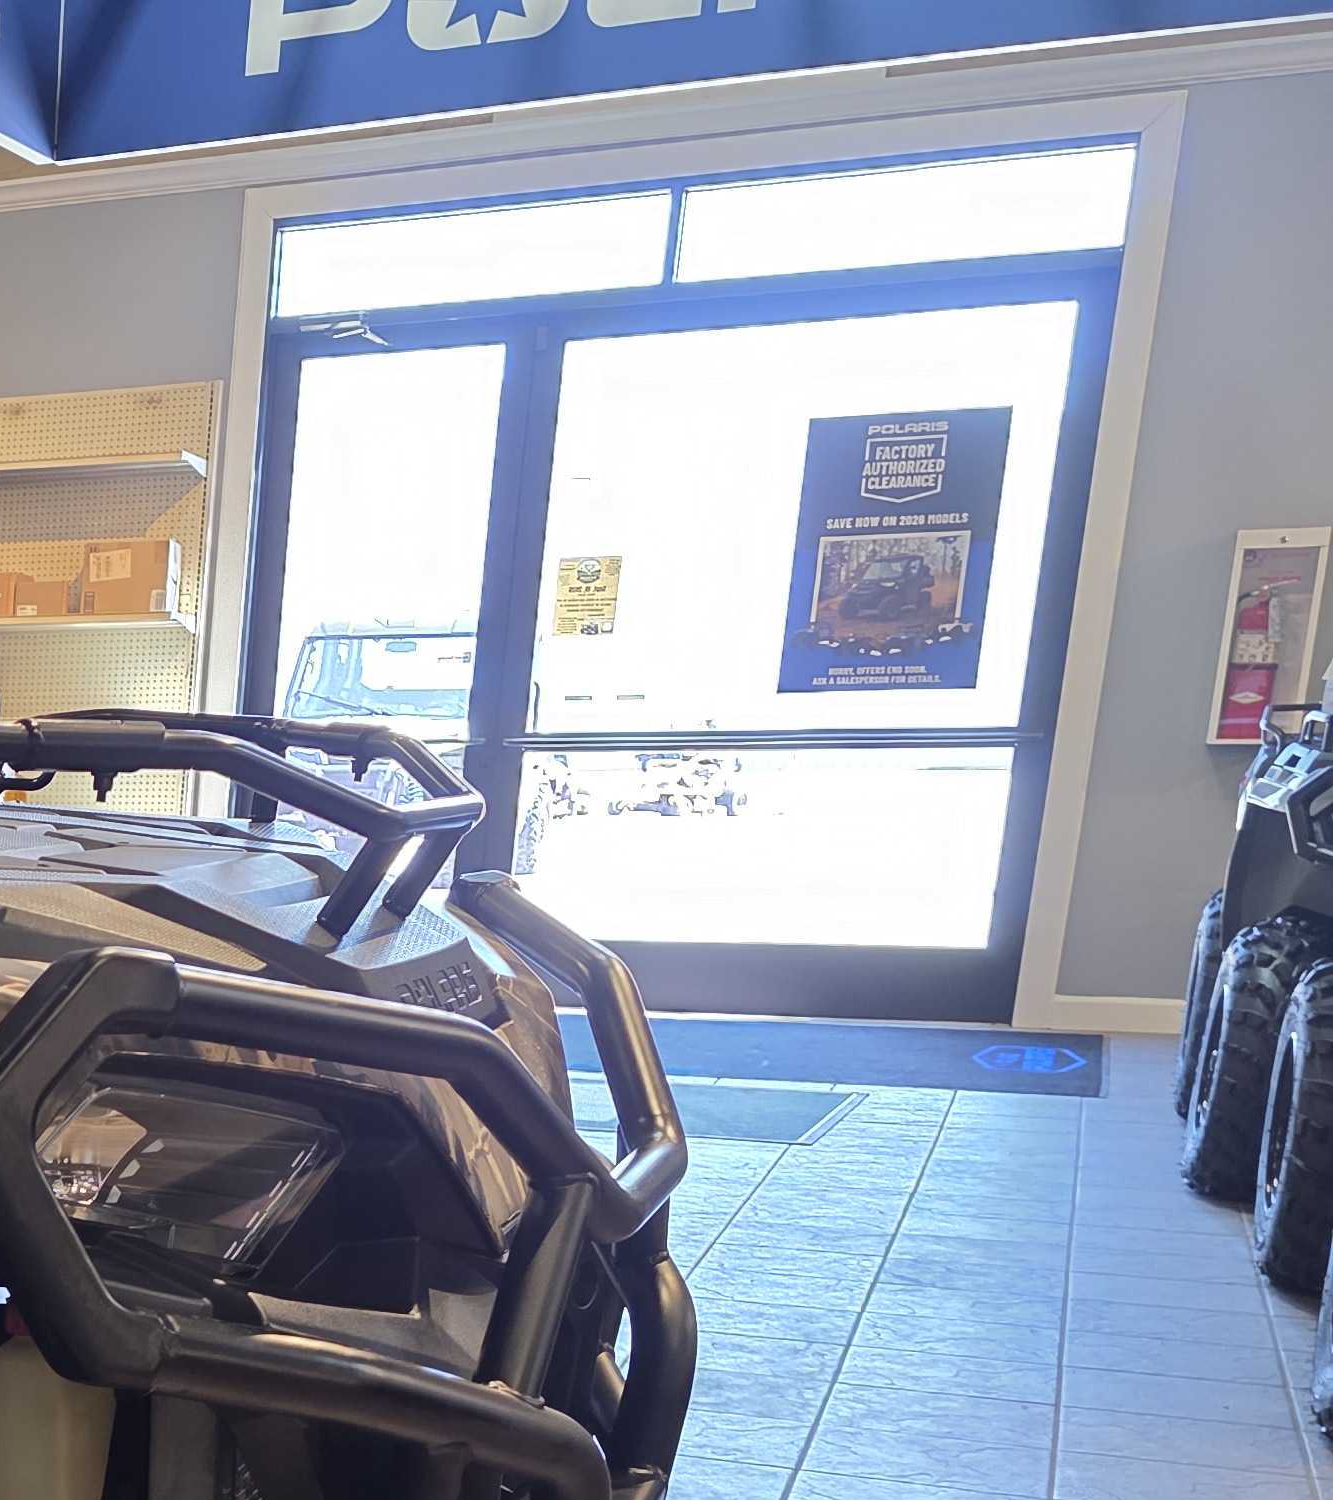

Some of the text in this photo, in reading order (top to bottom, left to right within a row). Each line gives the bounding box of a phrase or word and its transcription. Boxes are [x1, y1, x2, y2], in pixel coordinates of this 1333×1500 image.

[868, 421, 949, 435] POLARIS
[876, 444, 935, 460] FACTORY
[862, 459, 945, 476] AUTHORIZED
[868, 475, 936, 489] CLEARANCE
[826, 518, 853, 529] SAVE
[855, 516, 880, 528] NOW
[882, 516, 897, 527] ON
[928, 513, 969, 525] MODELS
